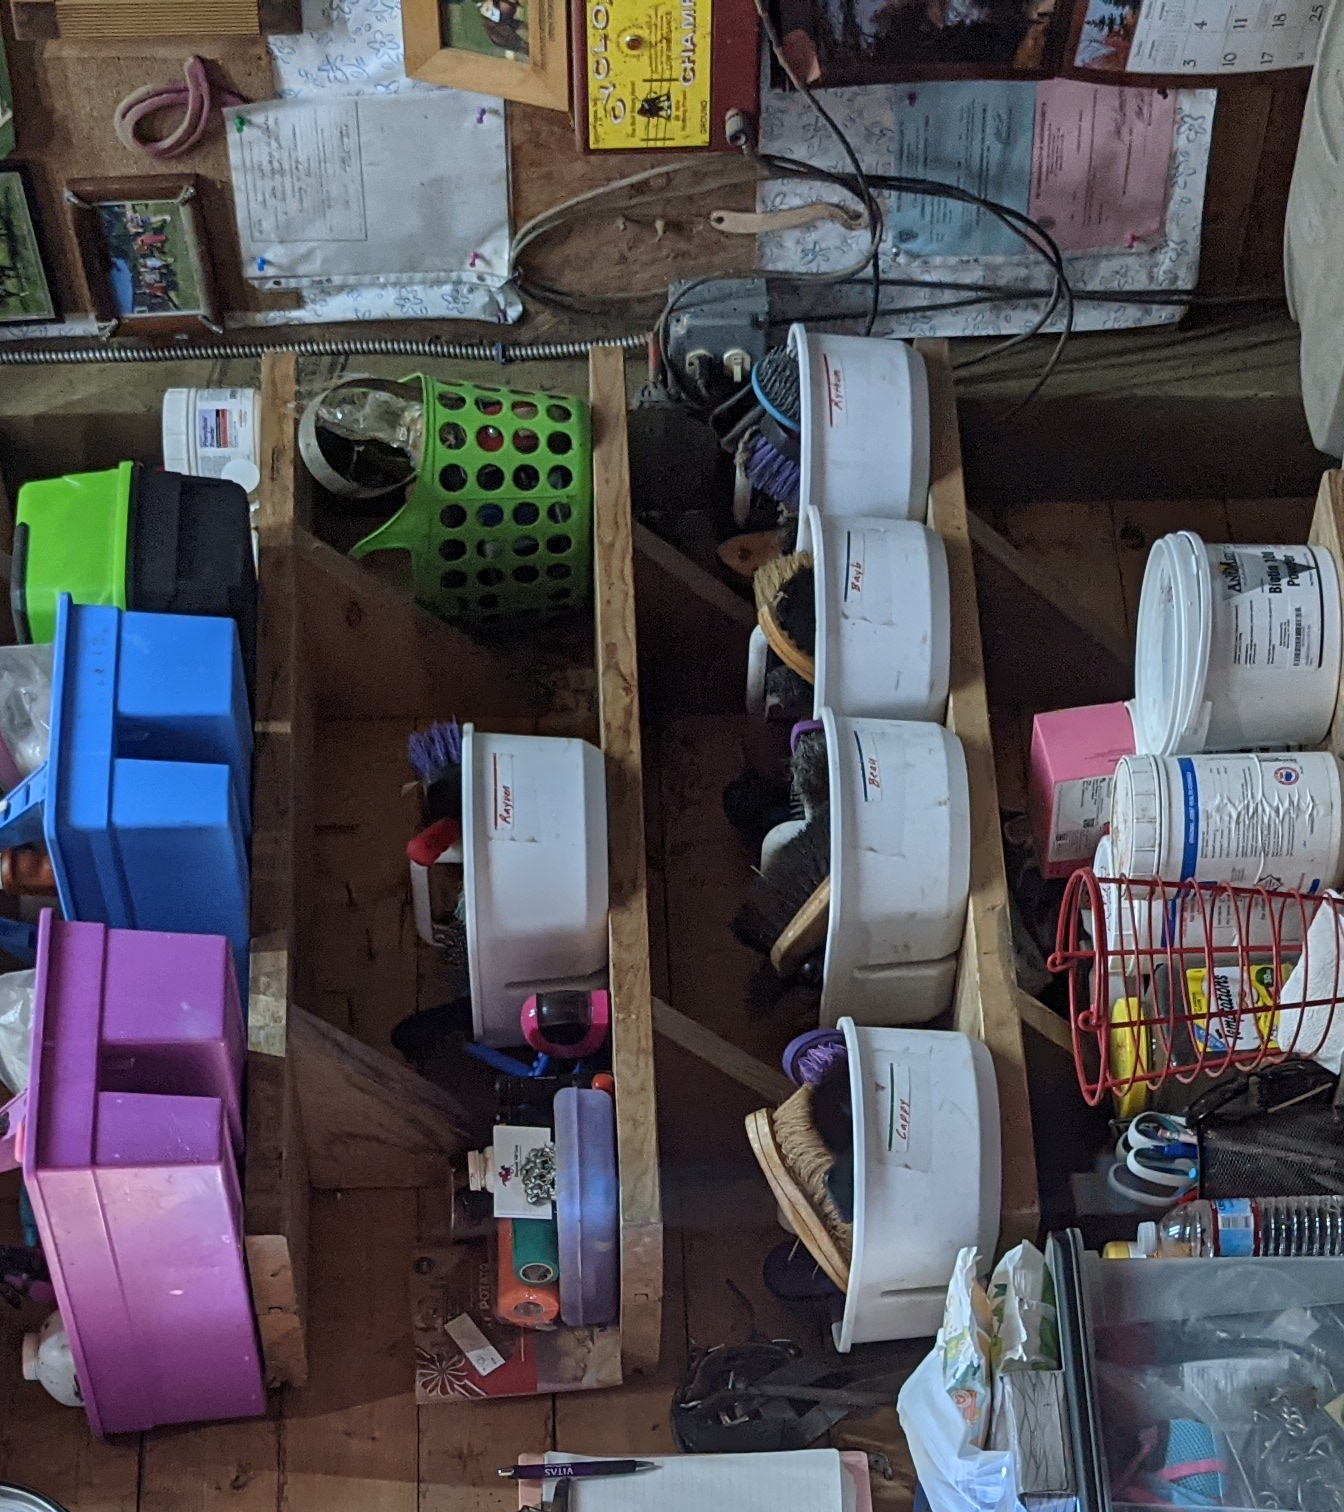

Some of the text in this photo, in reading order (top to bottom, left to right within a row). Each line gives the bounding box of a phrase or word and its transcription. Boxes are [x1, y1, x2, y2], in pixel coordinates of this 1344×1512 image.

[1271, 13, 1287, 28] 18
[1309, 4, 1325, 23] 25
[1193, 20, 1208, 30] 4
[1233, 17, 1248, 29] 11
[587, 0, 626, 125] CYCLO
[1182, 58, 1197, 68] 3
[1222, 52, 1237, 67] 10
[1259, 51, 1274, 65] 17
[699, 100, 708, 135] GROUND
[1283, 554, 1301, 587] Powder
[1266, 565, 1282, 594] Biotin
[895, 1098, 910, 1140] Cappy
[479, 1262, 490, 1310] POTATO
[544, 1466, 574, 1476] VITAS
